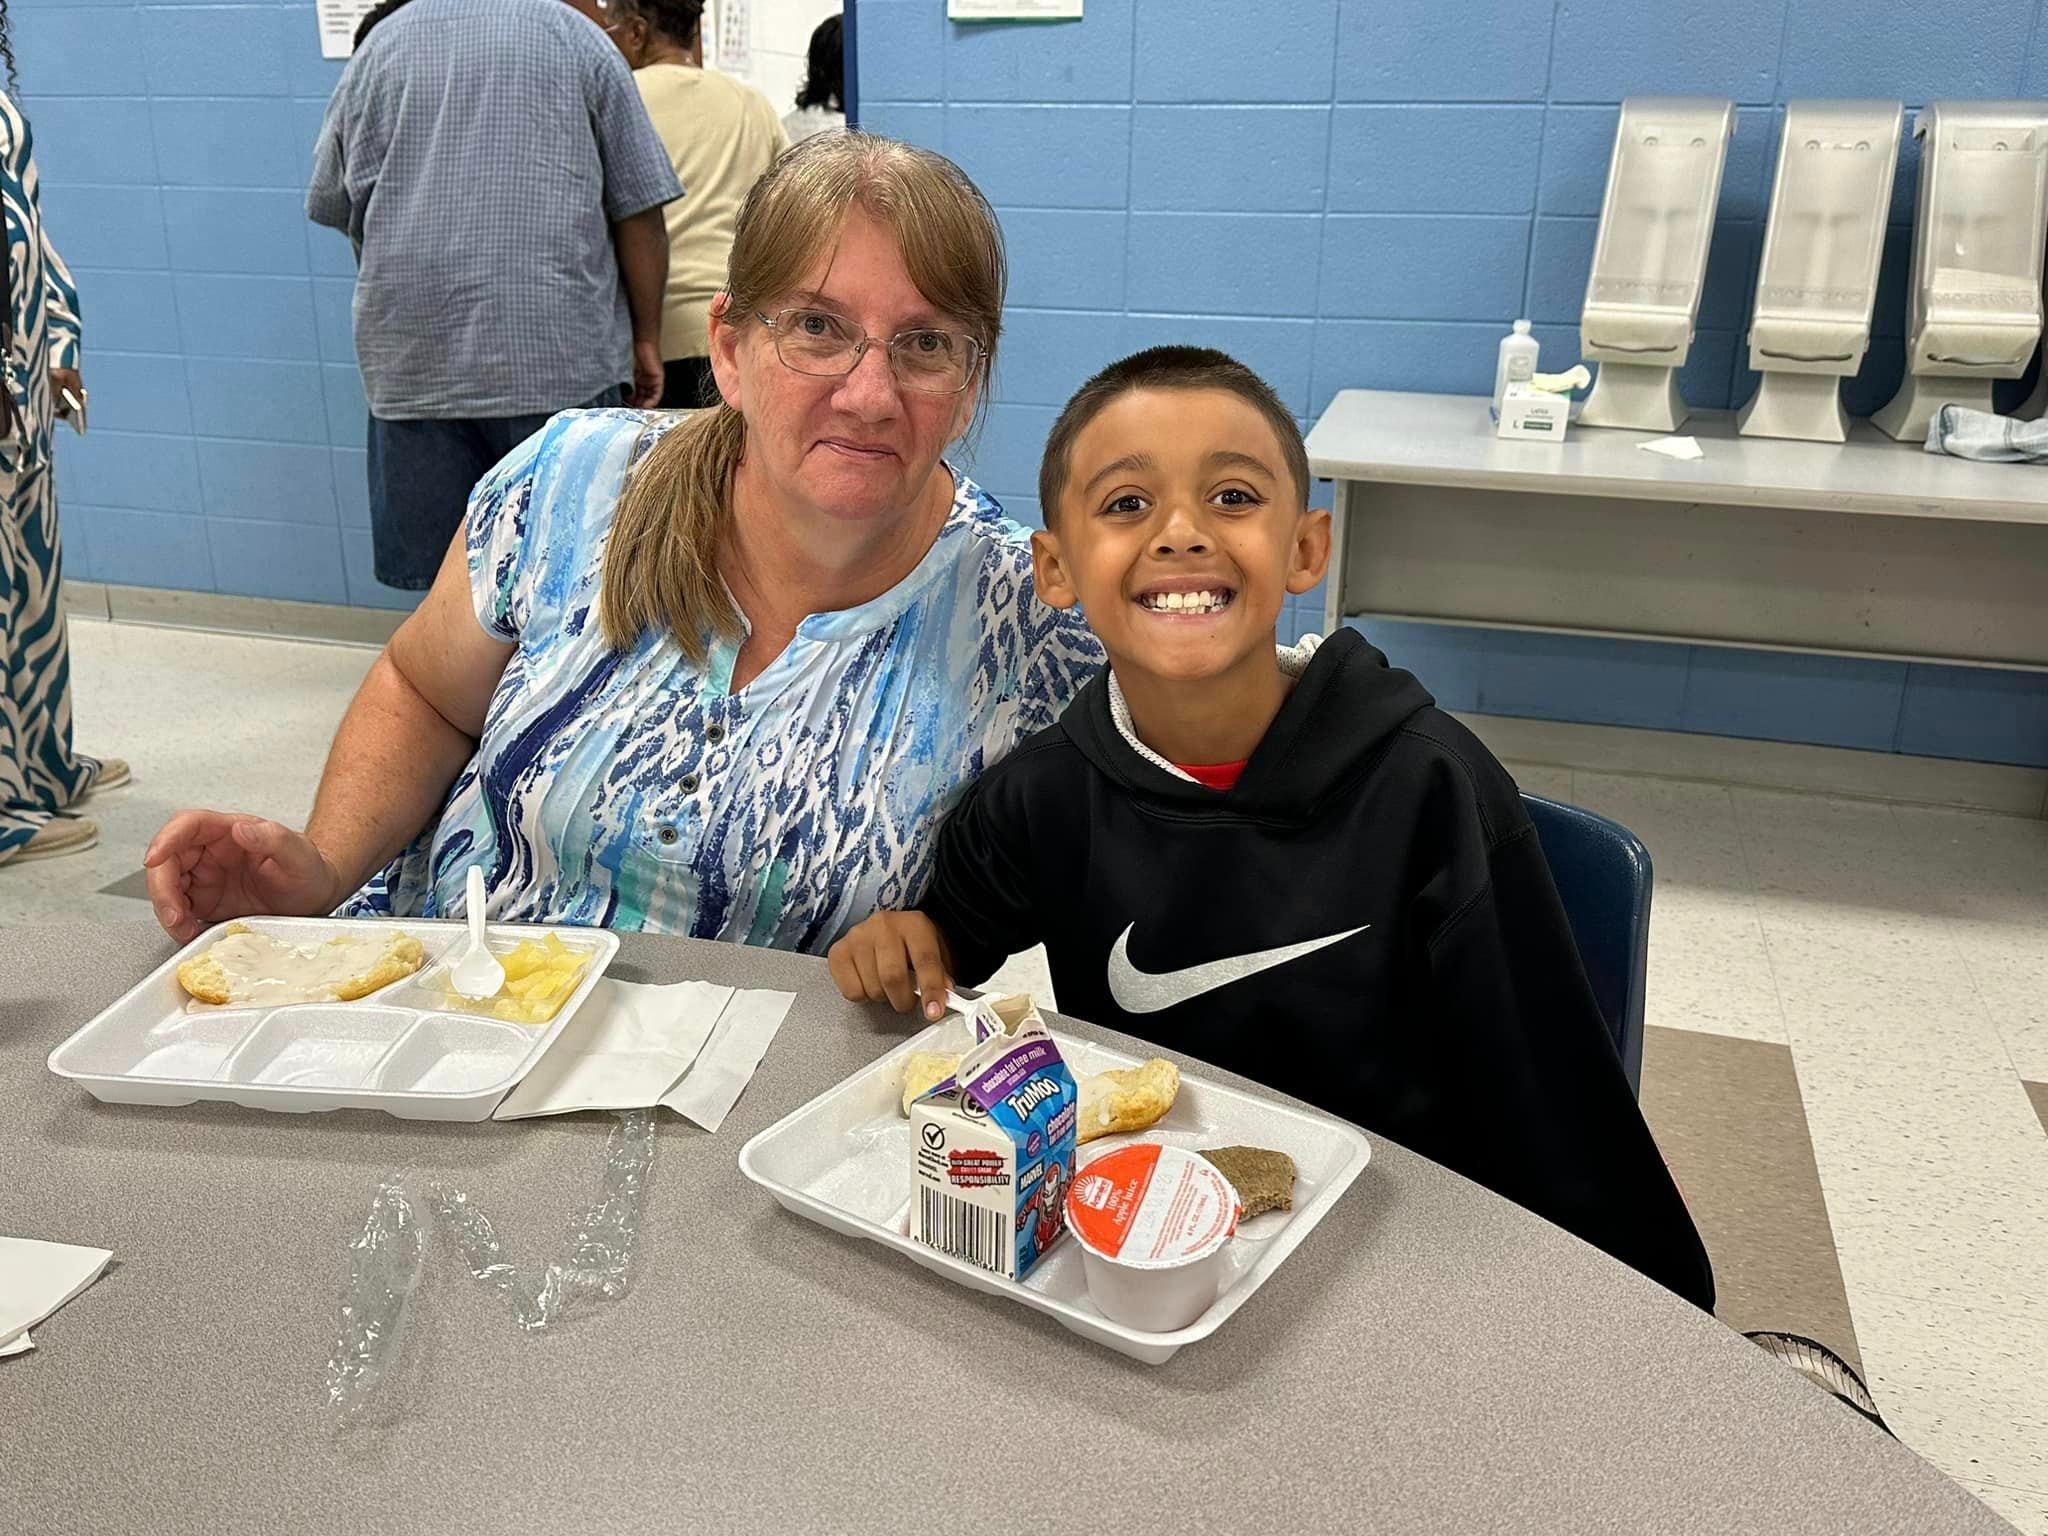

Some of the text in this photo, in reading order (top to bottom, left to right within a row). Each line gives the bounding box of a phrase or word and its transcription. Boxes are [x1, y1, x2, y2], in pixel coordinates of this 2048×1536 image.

[981, 1068, 1009, 1094] chocolate
[1012, 1053, 1030, 1069] free
[1028, 1046, 1047, 1060] milk
[1007, 1078, 1060, 1122] TruMoo
[951, 1175, 1010, 1185] RESPONSIBILITY
[1020, 1162, 1043, 1191] MARVEL
[1105, 1188, 1123, 1210] 100%
[1120, 1178, 1138, 1202] Juice
[1112, 1200, 1131, 1226] Apple
